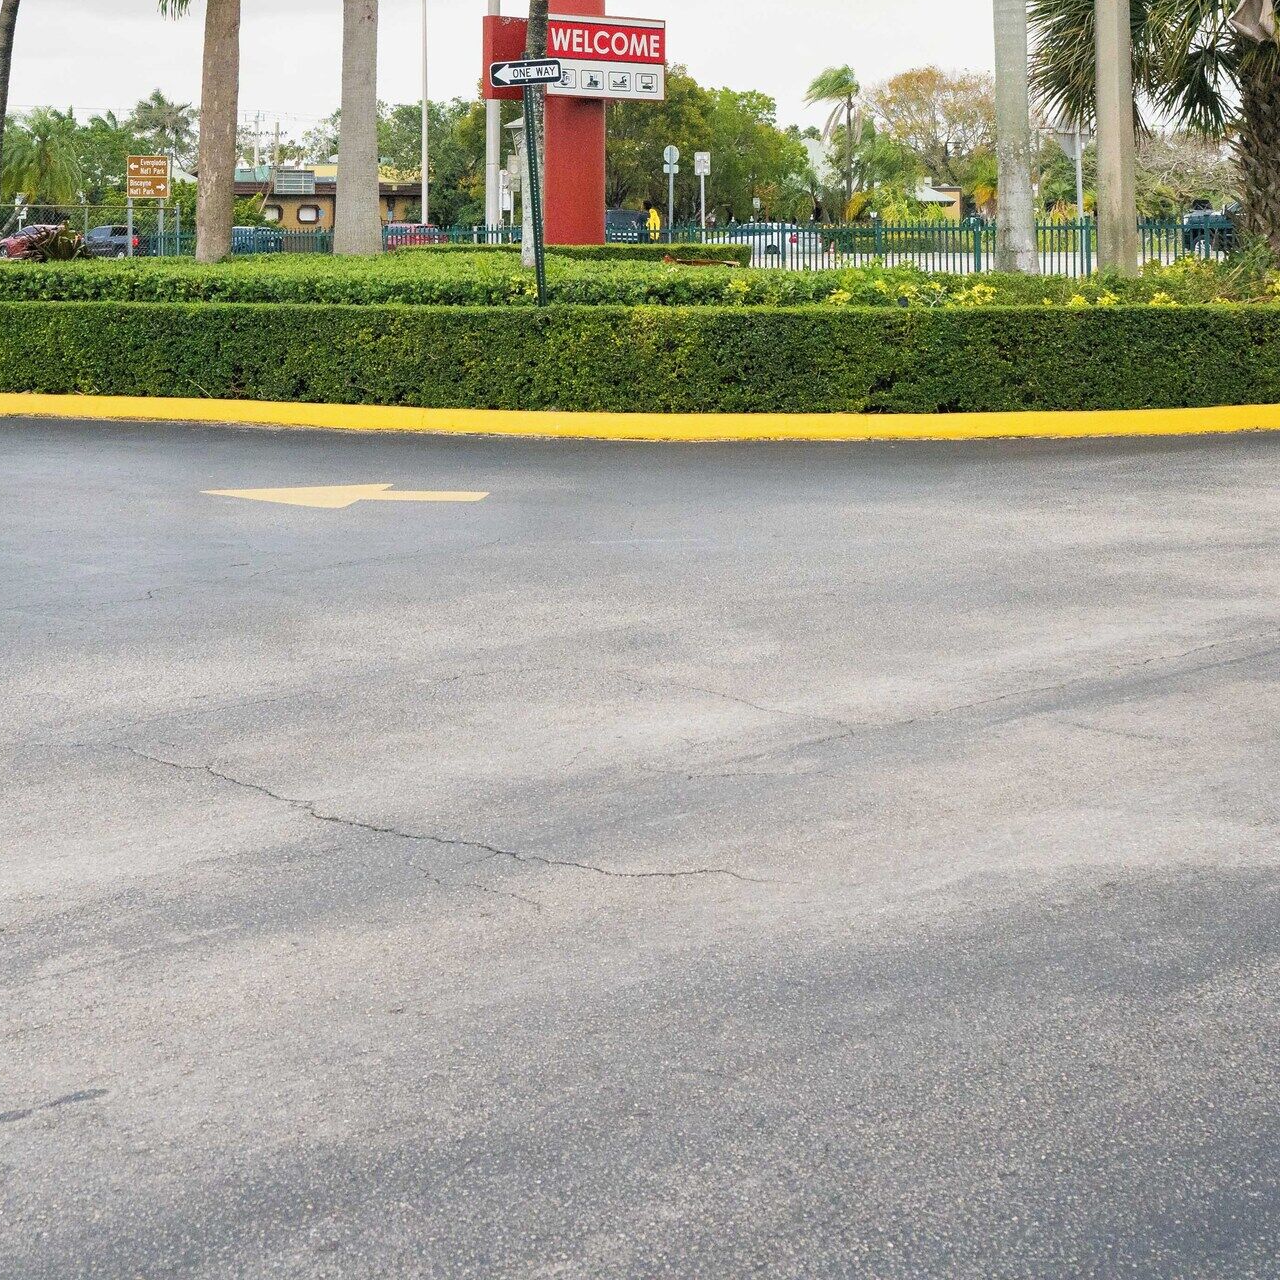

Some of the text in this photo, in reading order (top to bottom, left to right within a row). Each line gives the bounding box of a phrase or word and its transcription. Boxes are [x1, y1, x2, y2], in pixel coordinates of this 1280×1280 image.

[551, 27, 660, 58] WELCOME
[512, 66, 556, 78] ONE WAY
[140, 159, 167, 167] Everglades
